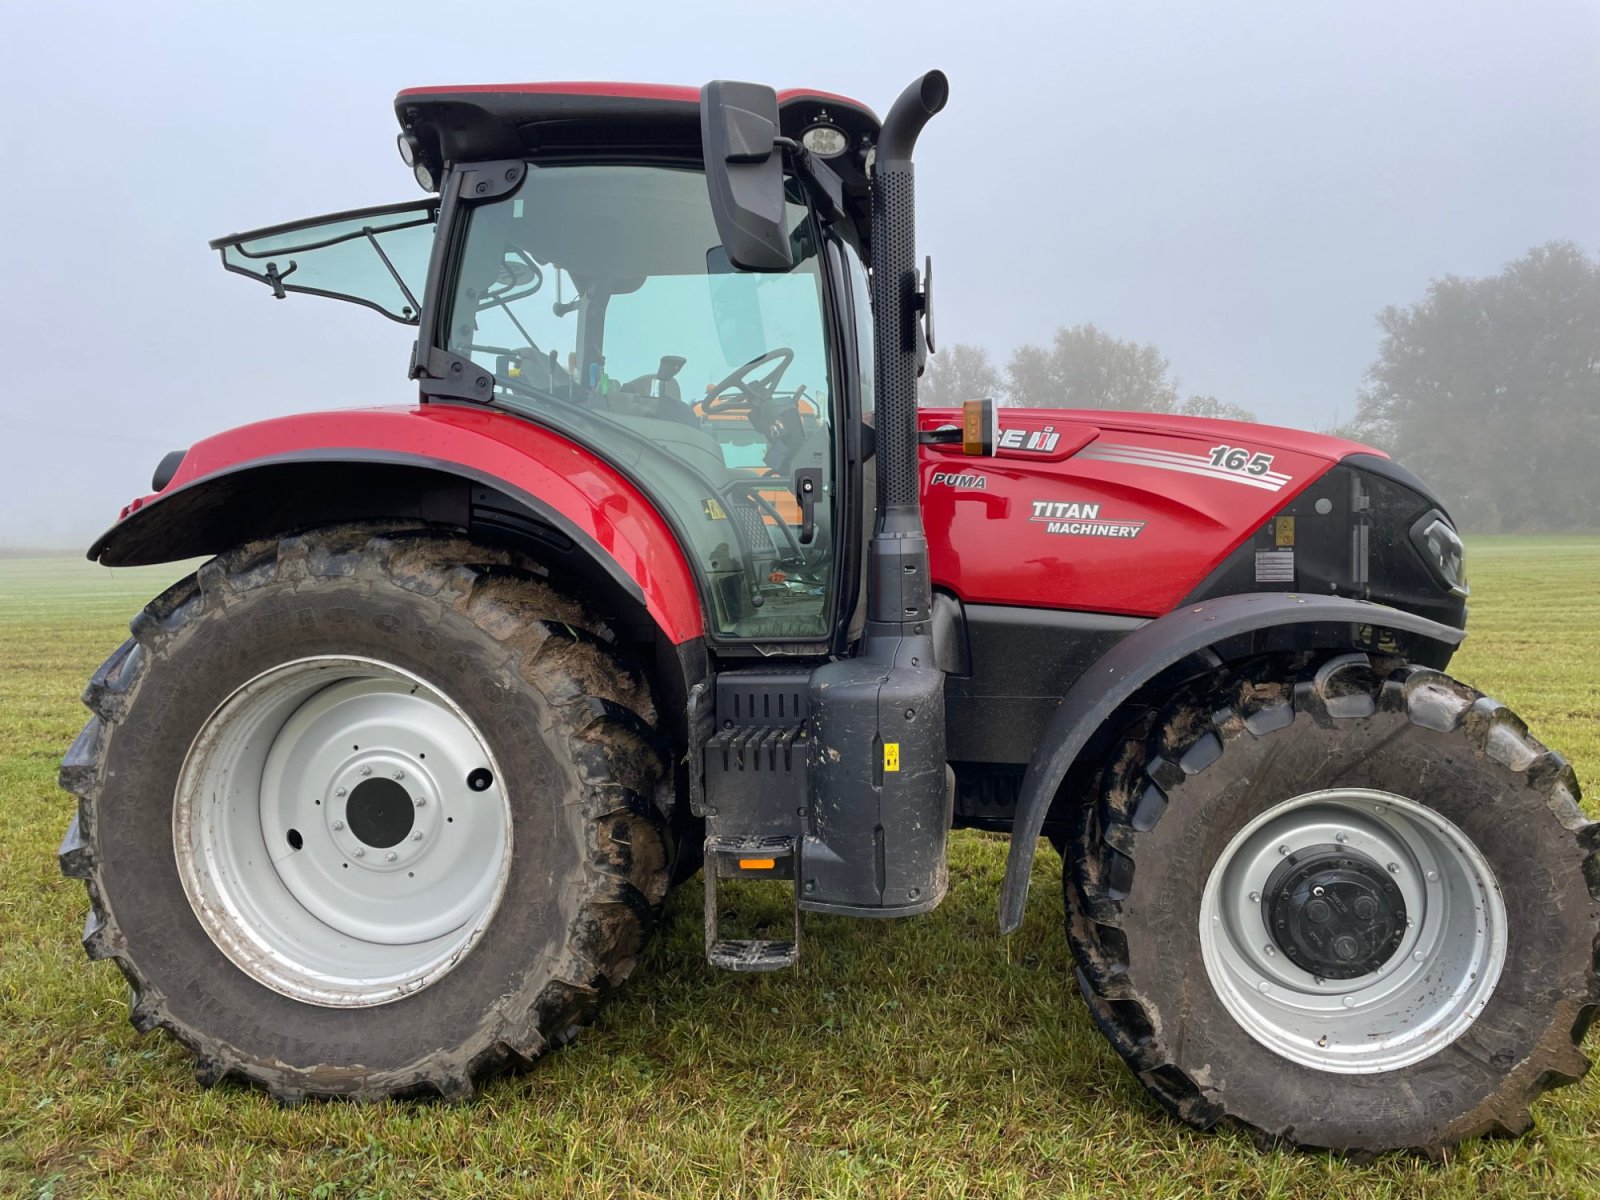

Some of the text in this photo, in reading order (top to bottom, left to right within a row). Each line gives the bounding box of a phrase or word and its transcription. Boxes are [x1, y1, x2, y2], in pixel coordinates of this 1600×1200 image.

[1209, 445, 1274, 475] 165
[931, 473, 986, 489] PUMA
[1033, 502, 1099, 519] TITAN
[1047, 523, 1140, 537] MACHINERY
